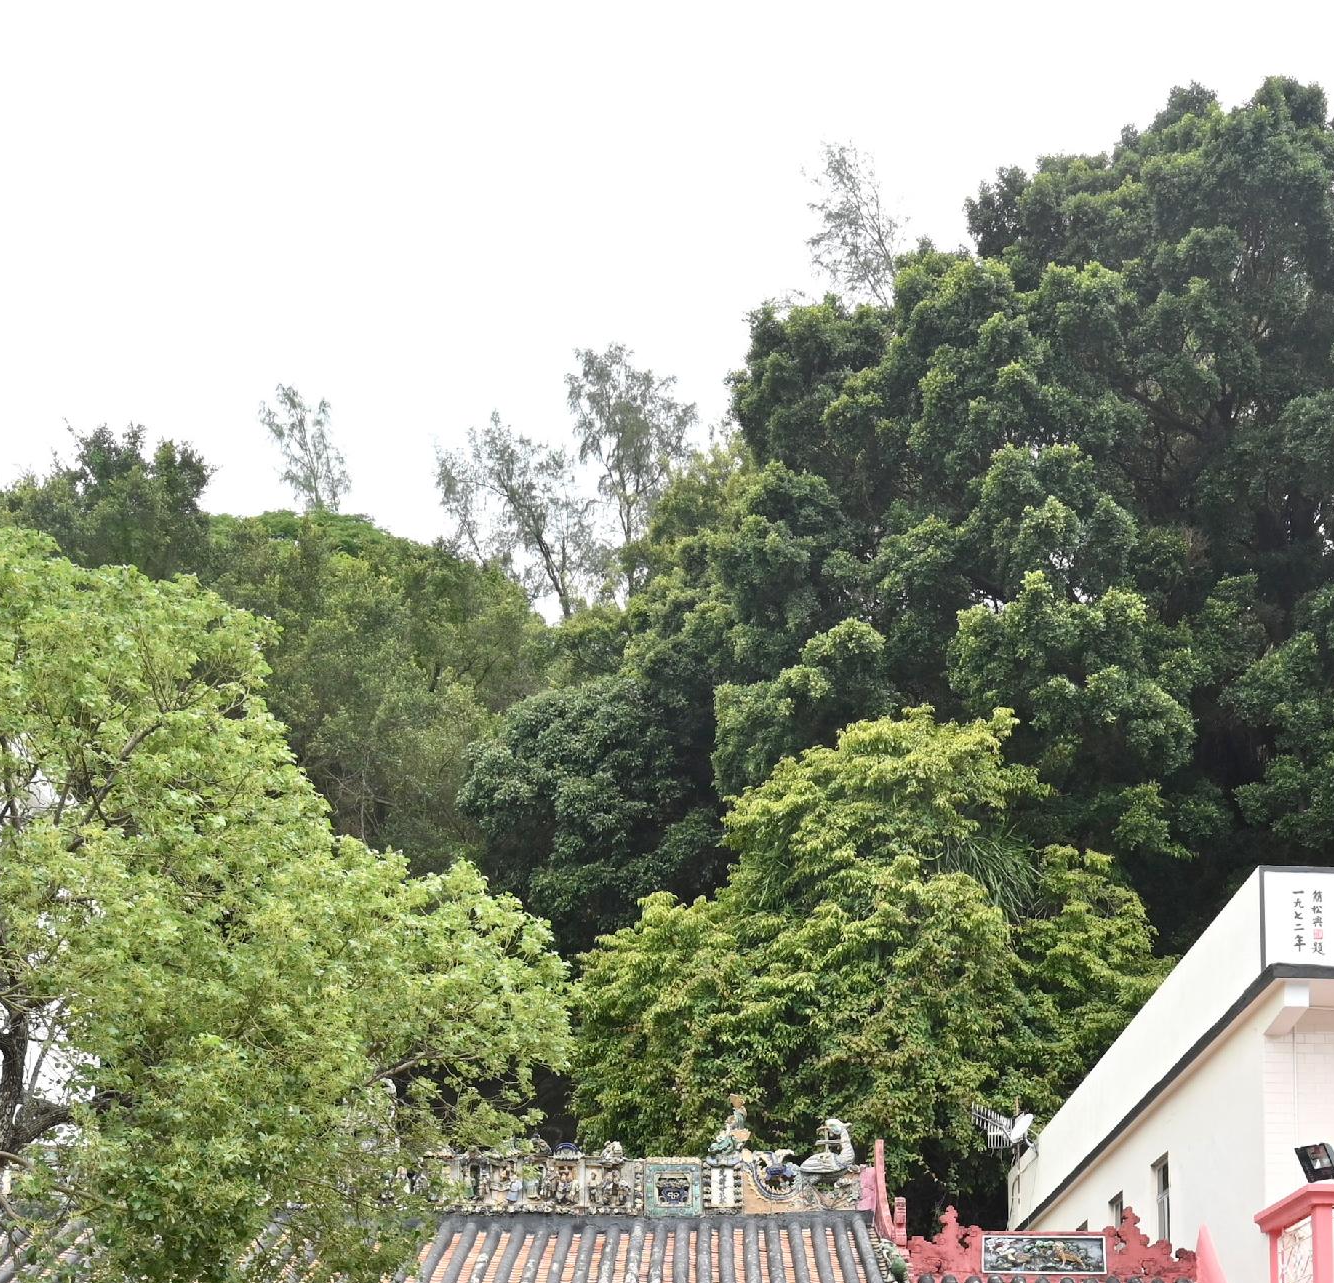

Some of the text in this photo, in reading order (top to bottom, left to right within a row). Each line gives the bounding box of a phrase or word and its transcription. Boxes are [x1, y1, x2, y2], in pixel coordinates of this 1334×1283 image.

[1292, 889, 1306, 952] 一九七二年
